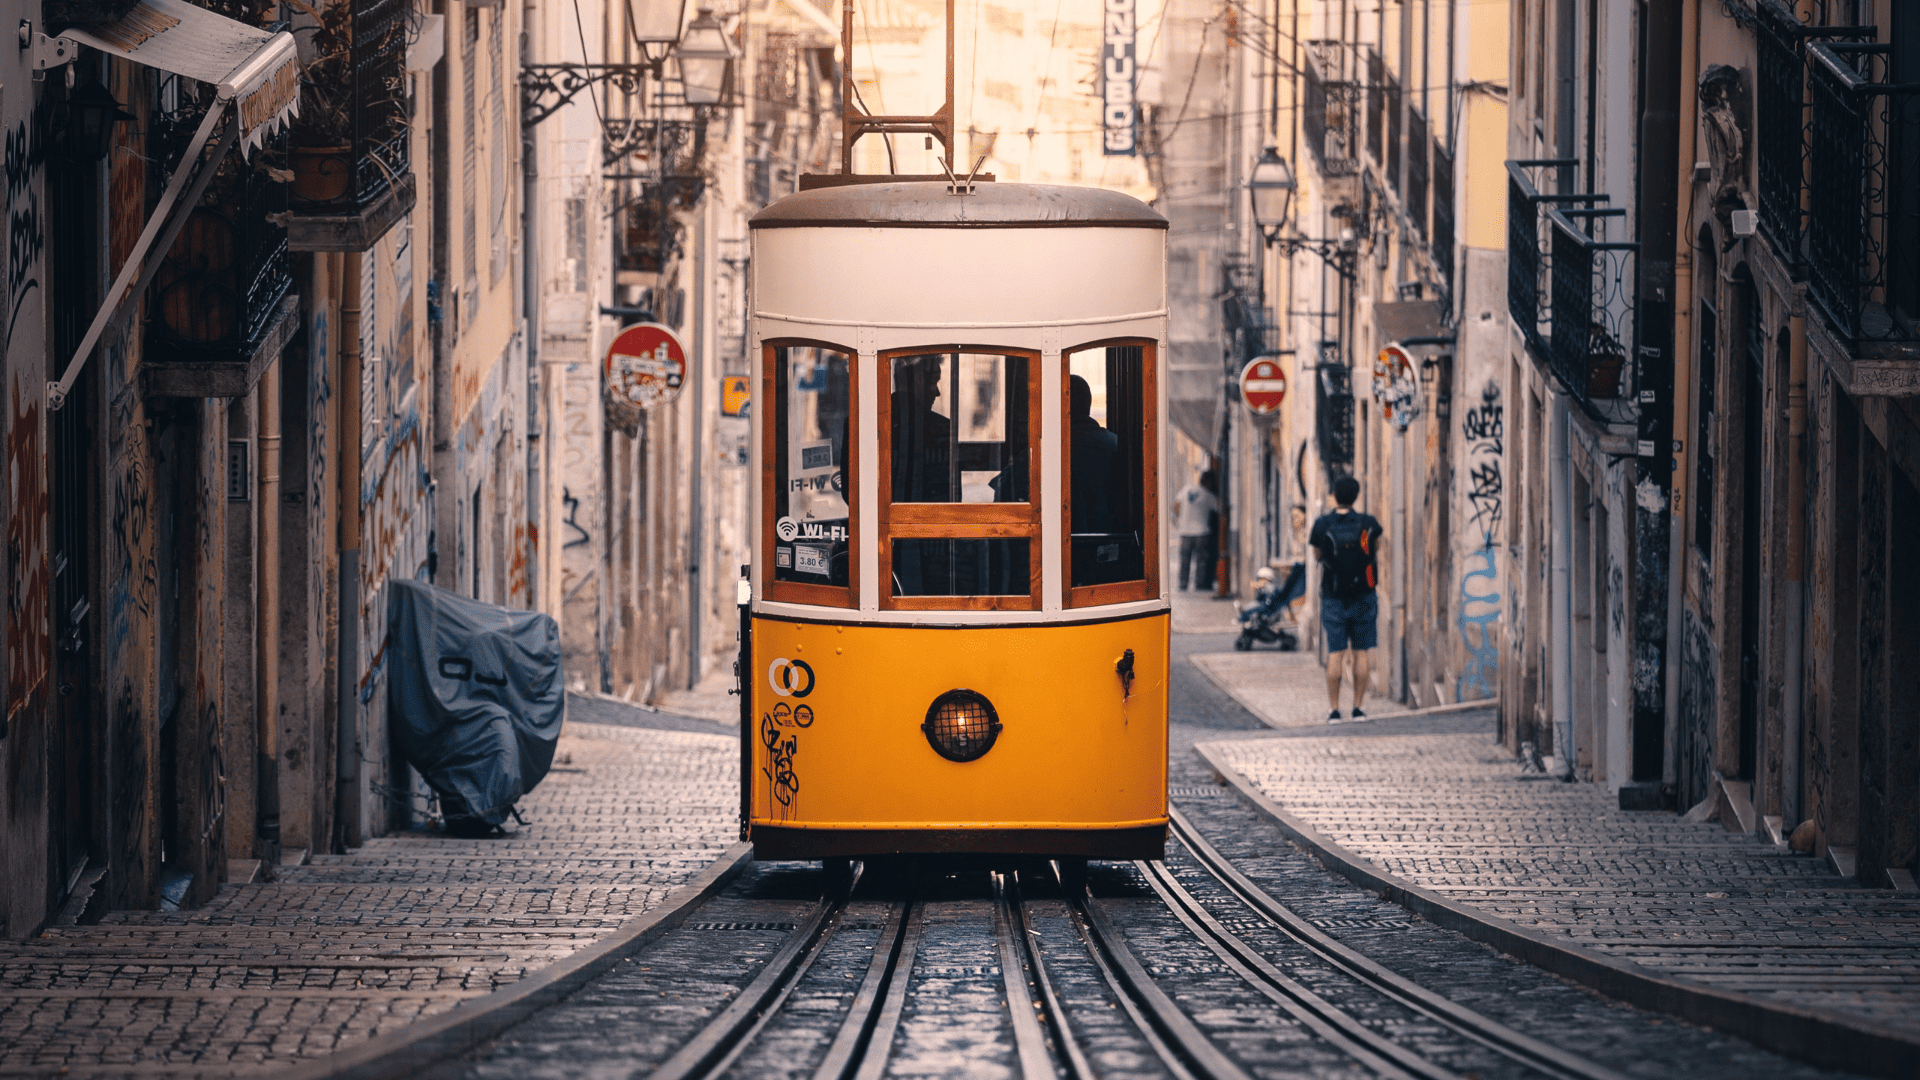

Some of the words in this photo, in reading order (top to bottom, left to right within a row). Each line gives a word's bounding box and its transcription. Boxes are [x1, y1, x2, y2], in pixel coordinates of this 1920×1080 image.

[802, 523, 846, 541] WI-FI
[800, 556, 816, 567] 3.80
[818, 559, 824, 568] €
